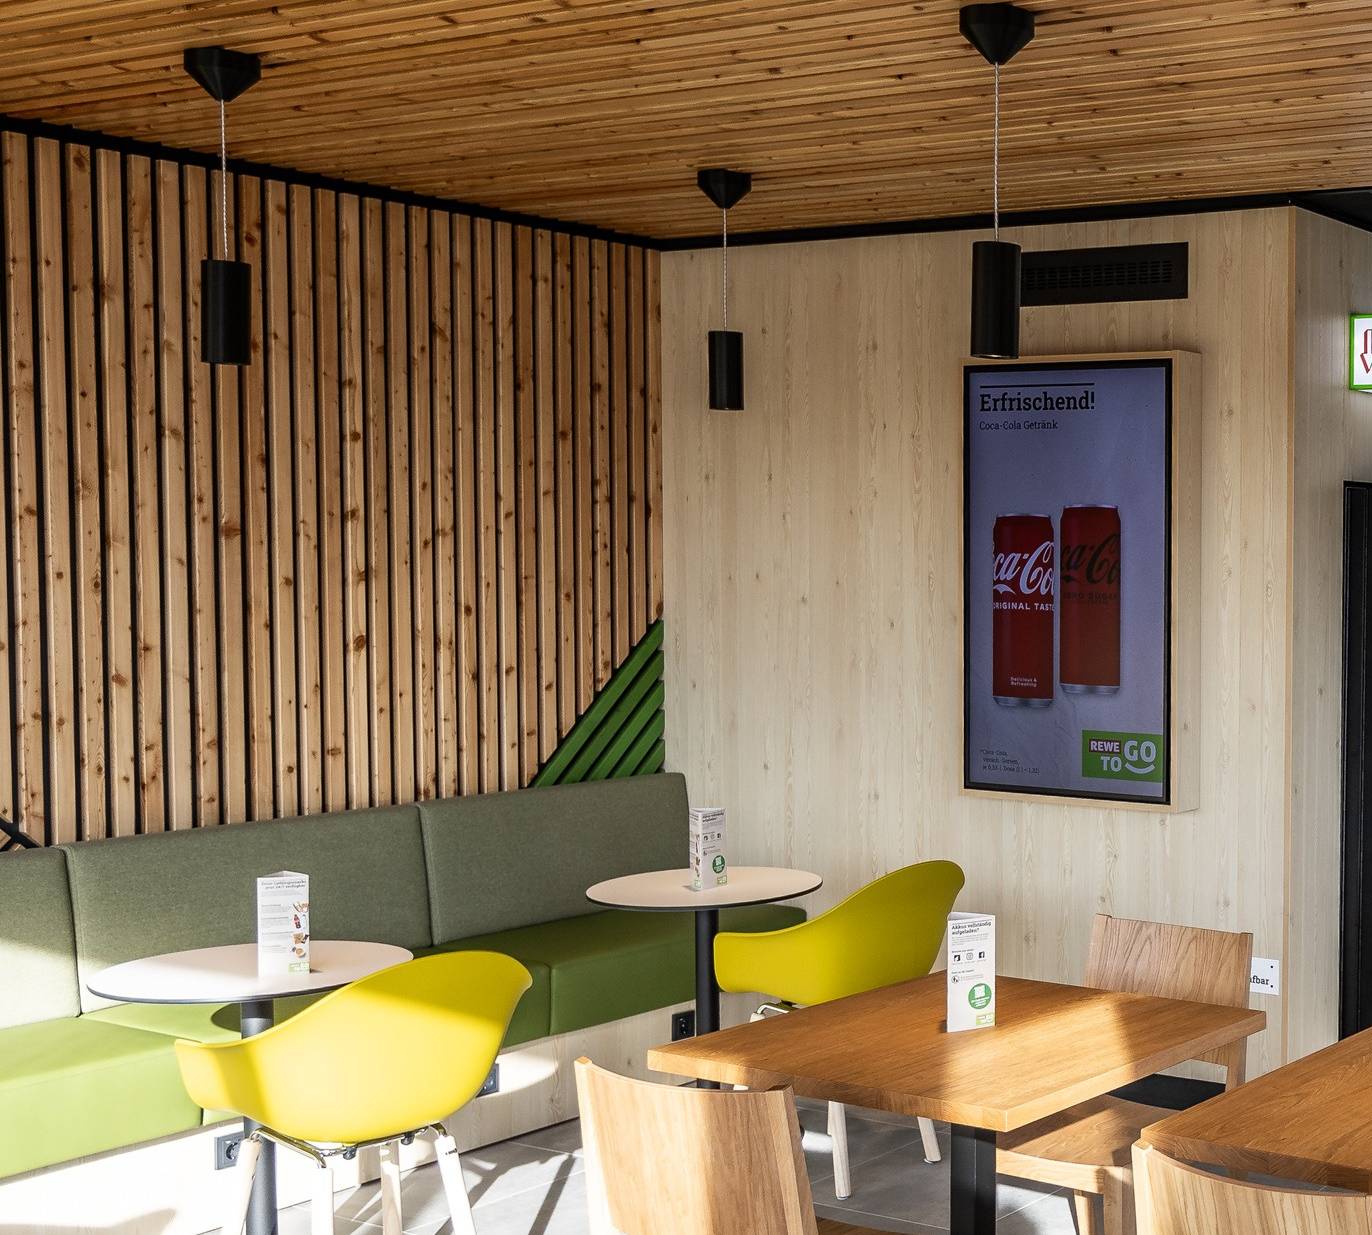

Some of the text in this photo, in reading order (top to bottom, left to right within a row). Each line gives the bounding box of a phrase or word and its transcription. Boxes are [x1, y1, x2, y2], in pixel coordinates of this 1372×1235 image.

[980, 391, 1095, 412] Erfrischend!
[979, 419, 1059, 431] Coca-Cola Getränk
[1090, 740, 1120, 752] REWE
[1123, 740, 1157, 763] GO
[1100, 756, 1122, 772] TO
